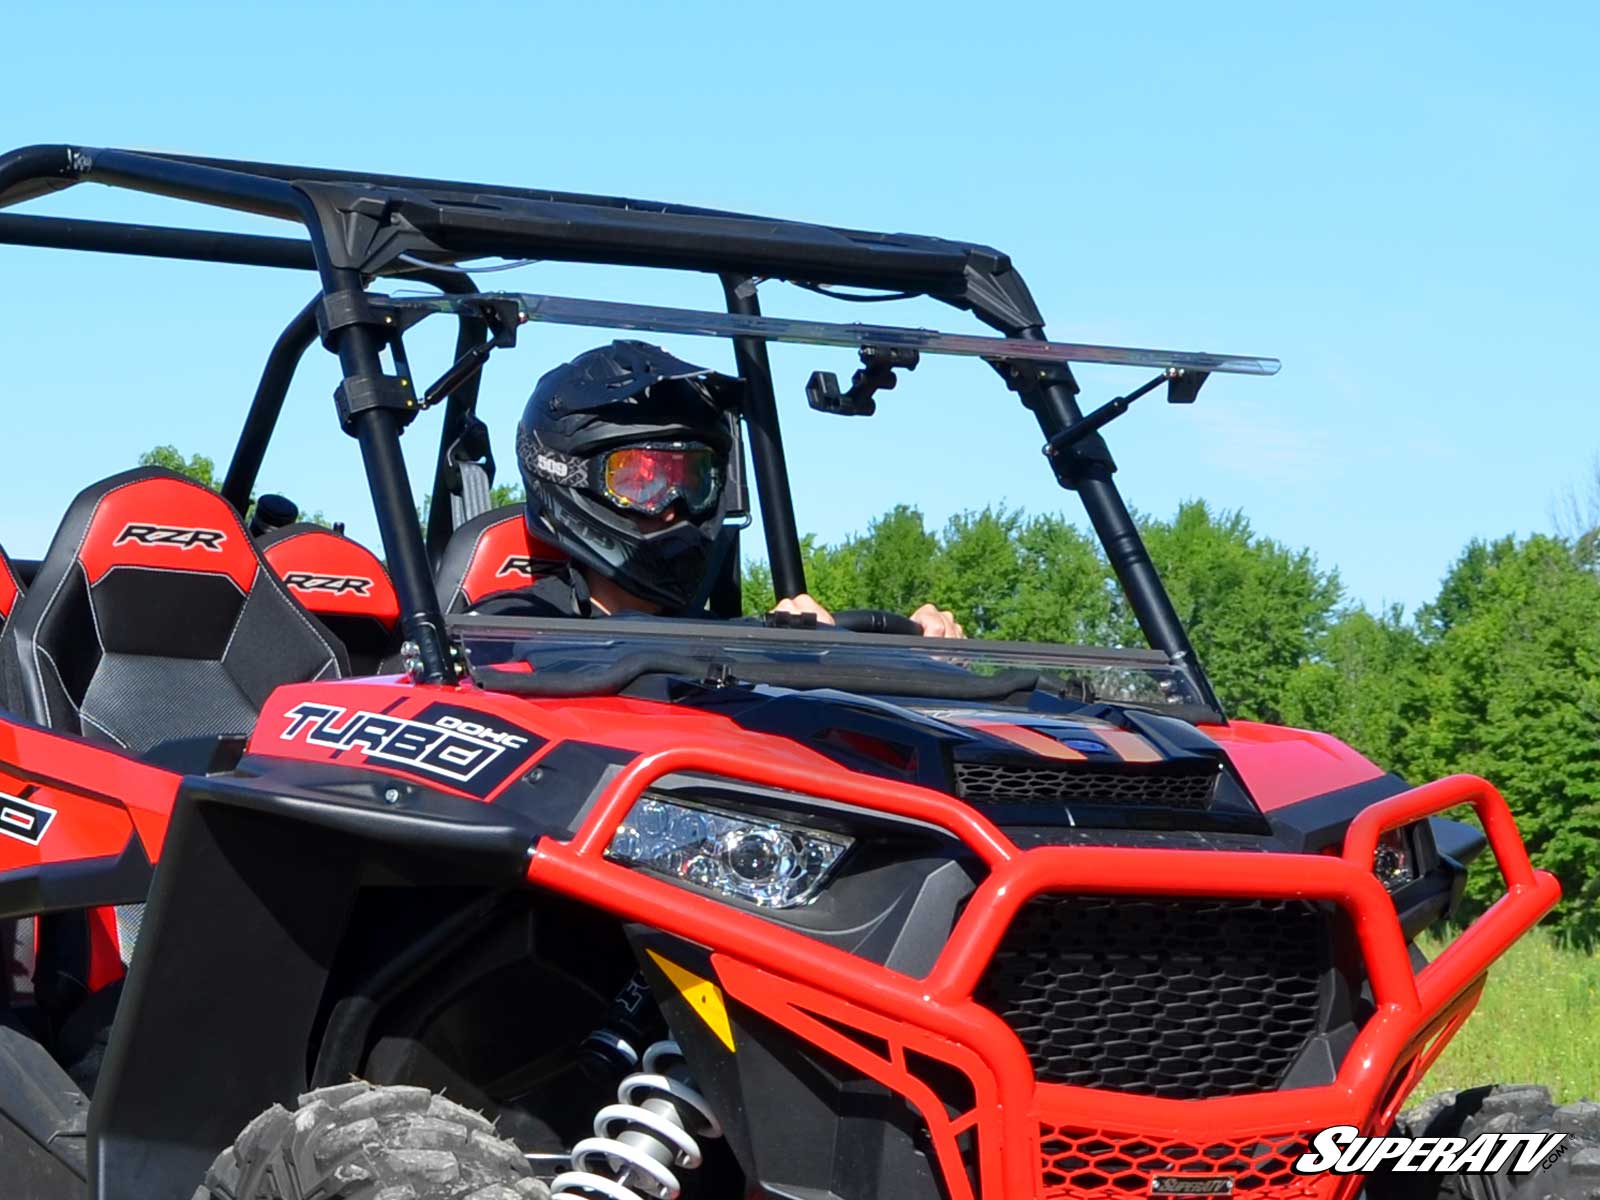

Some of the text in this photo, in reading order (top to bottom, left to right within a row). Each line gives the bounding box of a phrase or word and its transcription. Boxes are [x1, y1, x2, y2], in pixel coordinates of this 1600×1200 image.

[112, 522, 227, 552] RZR
[281, 571, 375, 597] RZR
[279, 701, 506, 782] TURBO
[435, 715, 528, 749] DOHC
